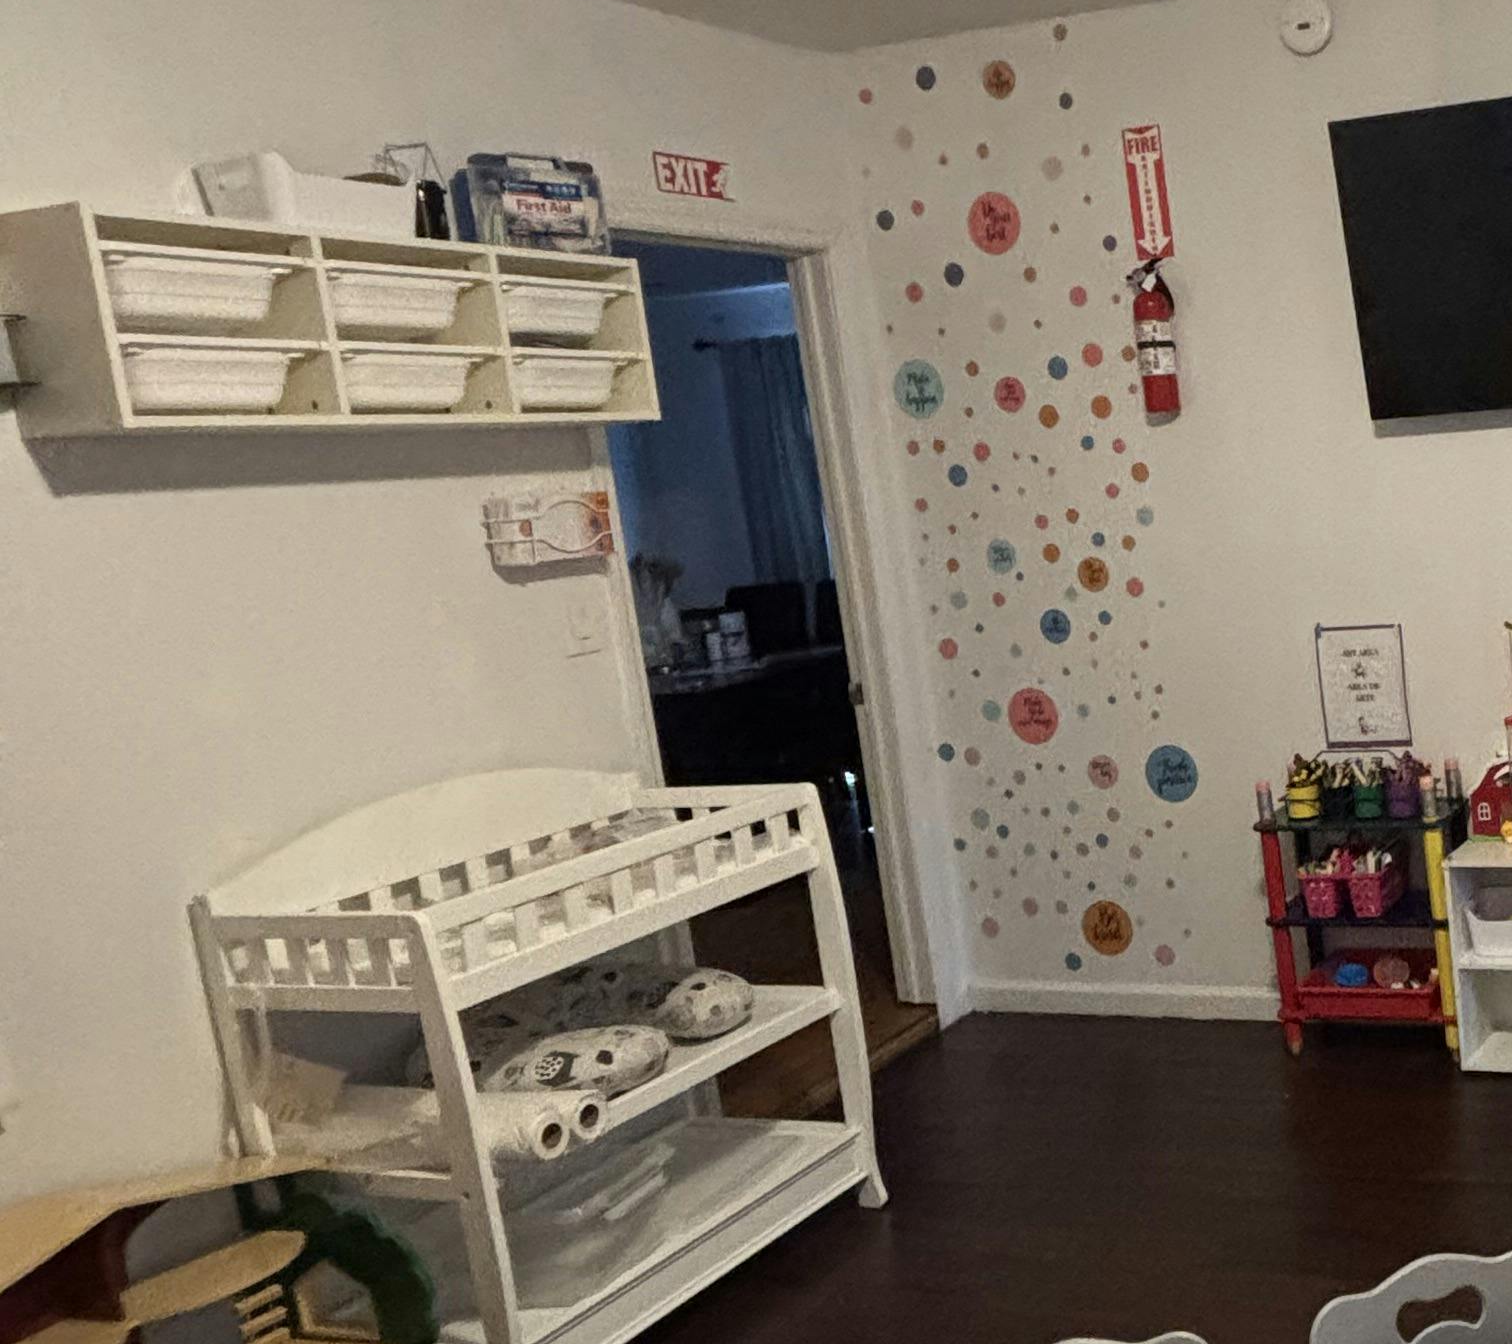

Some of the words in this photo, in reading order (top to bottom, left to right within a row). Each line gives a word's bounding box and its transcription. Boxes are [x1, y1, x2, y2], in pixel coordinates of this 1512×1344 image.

[1127, 136, 1159, 155] FIRE
[656, 156, 708, 196] EXIT
[516, 199, 546, 212] First
[550, 202, 572, 214] Aid
